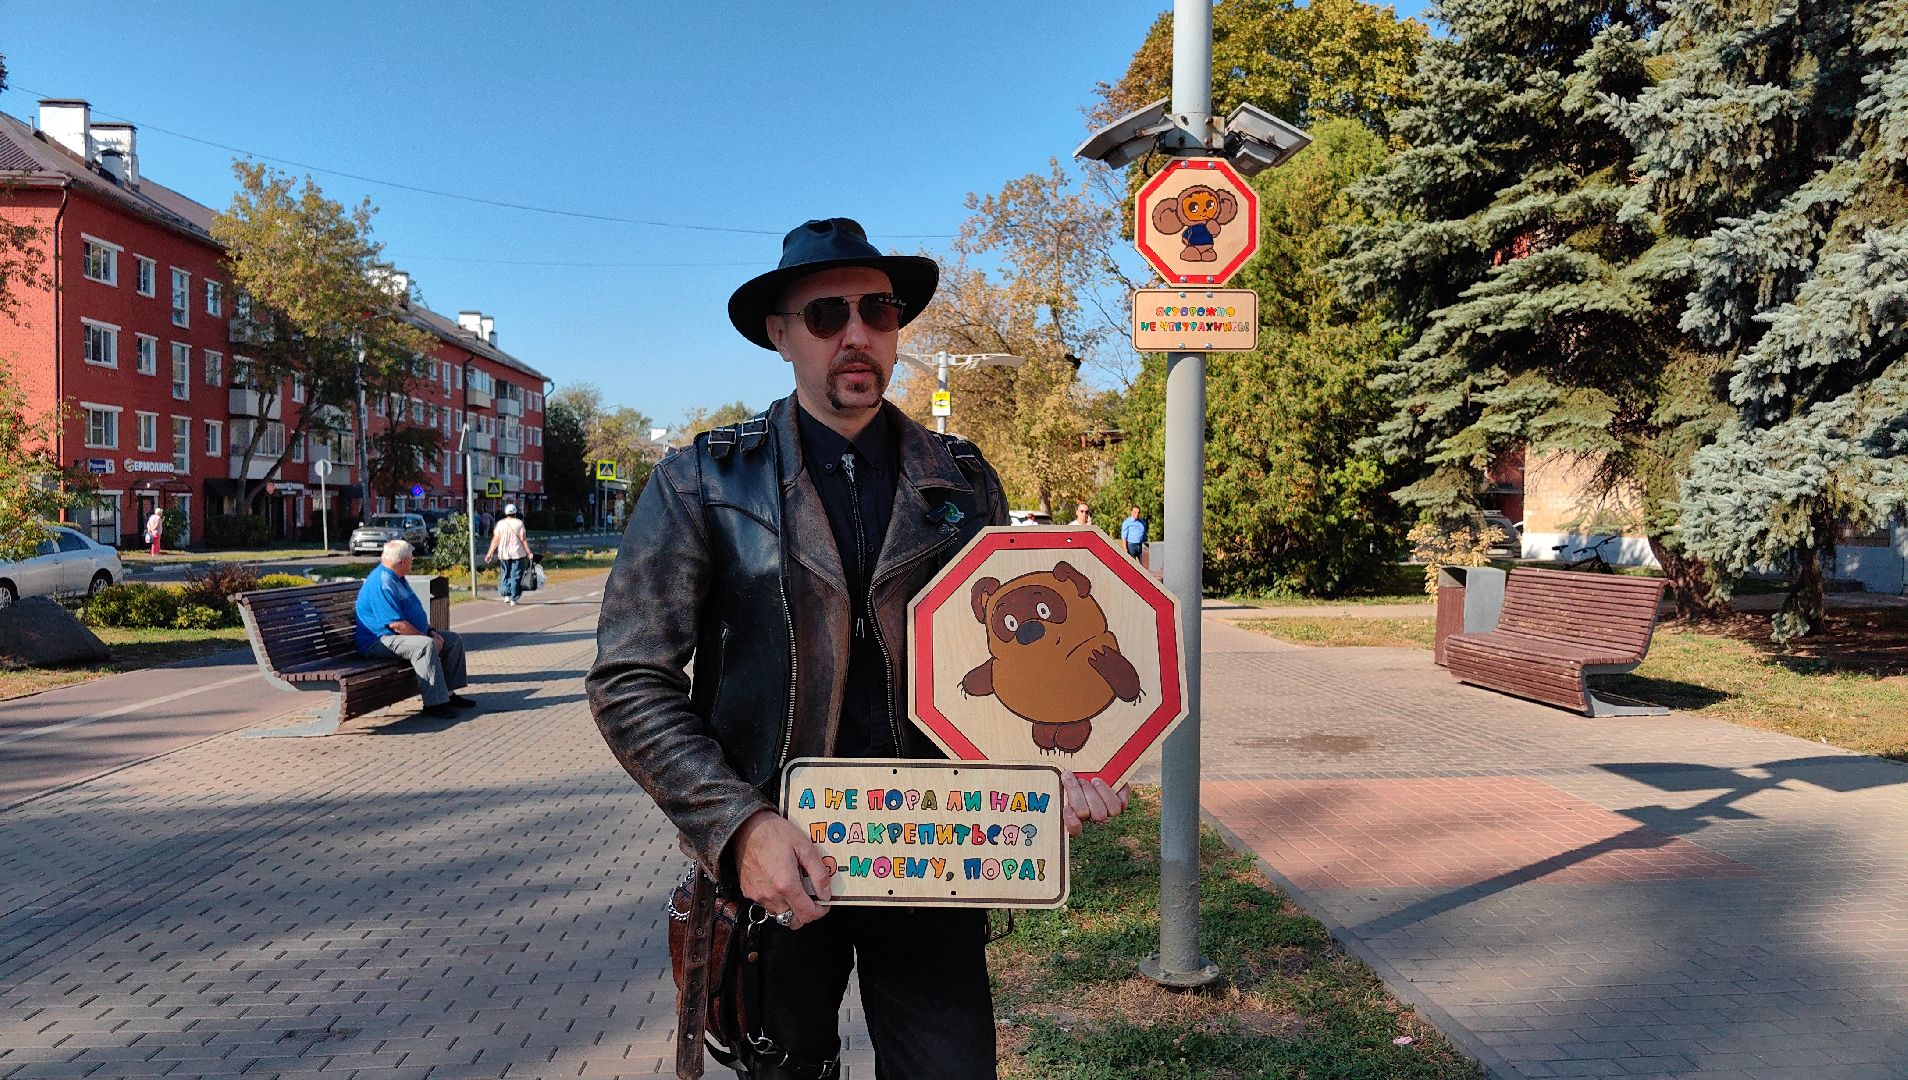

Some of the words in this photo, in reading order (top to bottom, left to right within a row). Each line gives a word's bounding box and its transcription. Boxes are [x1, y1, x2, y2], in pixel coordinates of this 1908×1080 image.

[1155, 306, 1236, 317] ОСТОРОЖНО
[1140, 321, 1157, 332] НЕ
[134, 461, 175, 473] ЕРМОЛИНО
[799, 788, 816, 810] А
[824, 788, 858, 810] НЕ
[867, 788, 938, 811] ПОРА
[946, 790, 982, 812] ЛИ
[989, 791, 1051, 813] НАМ
[809, 821, 1038, 847] ПОДКРЕПИТЬСЯ?
[803, 855, 955, 882] О-МОЕМУ,
[963, 857, 1046, 882] ПОРА!
